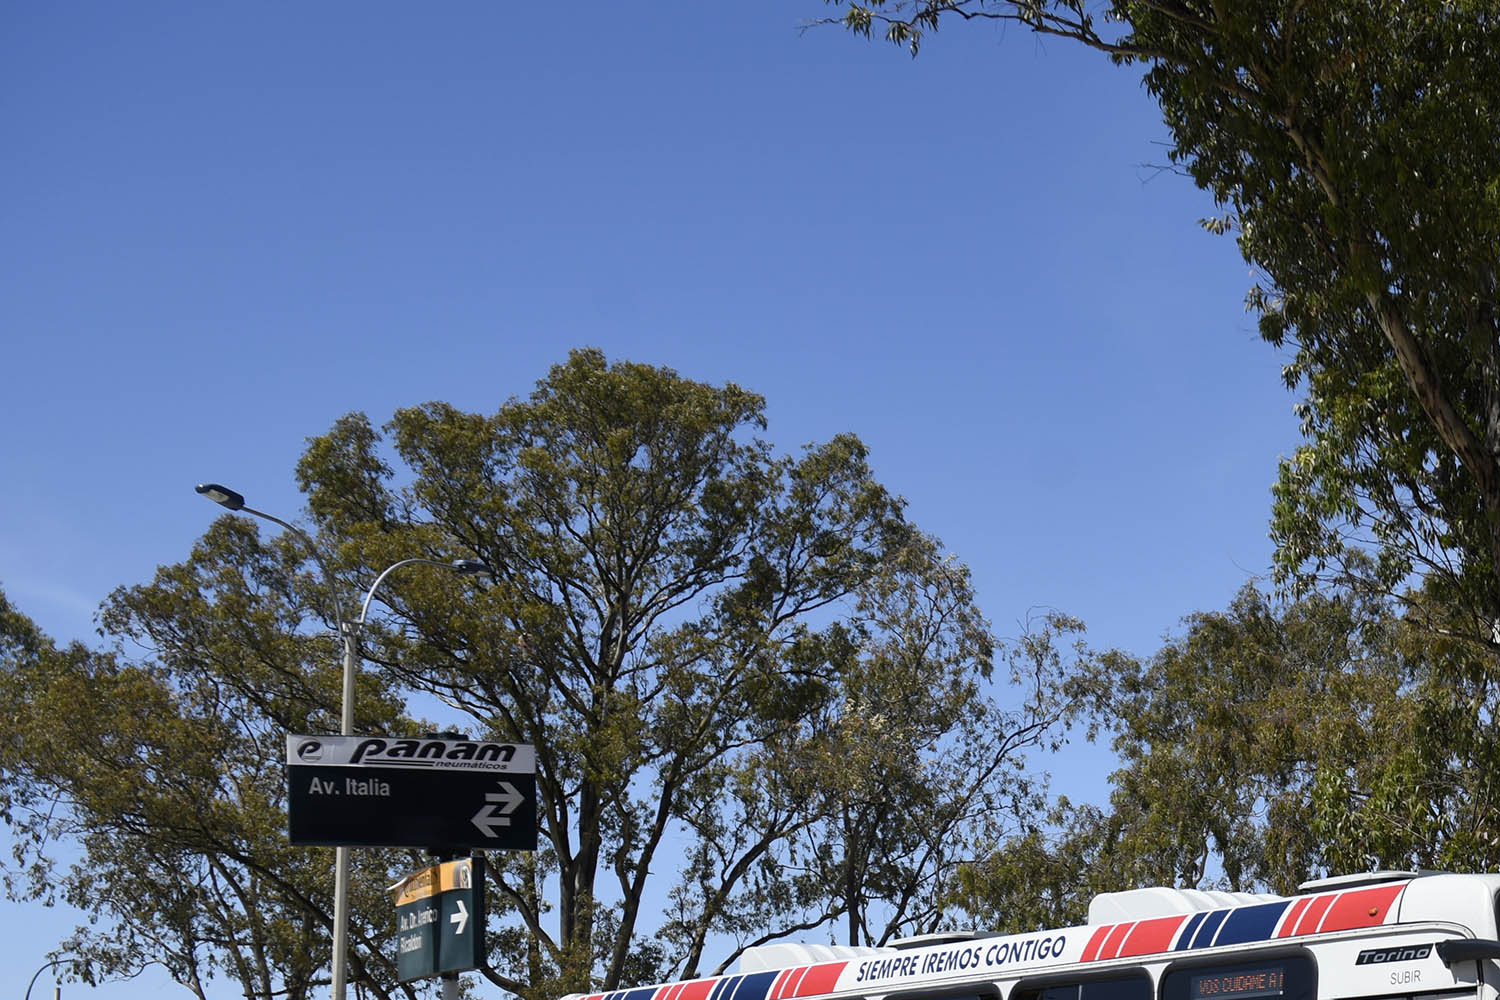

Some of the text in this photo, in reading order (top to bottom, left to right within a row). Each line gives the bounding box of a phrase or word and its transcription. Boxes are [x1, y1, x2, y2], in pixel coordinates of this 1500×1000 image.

[309, 777, 390, 796] Av. Italia
[857, 935, 1066, 982] SIEMPRE IREMOS CONTIGO
[1360, 949, 1430, 964] Torino
[1390, 970, 1421, 985] SUBIR
